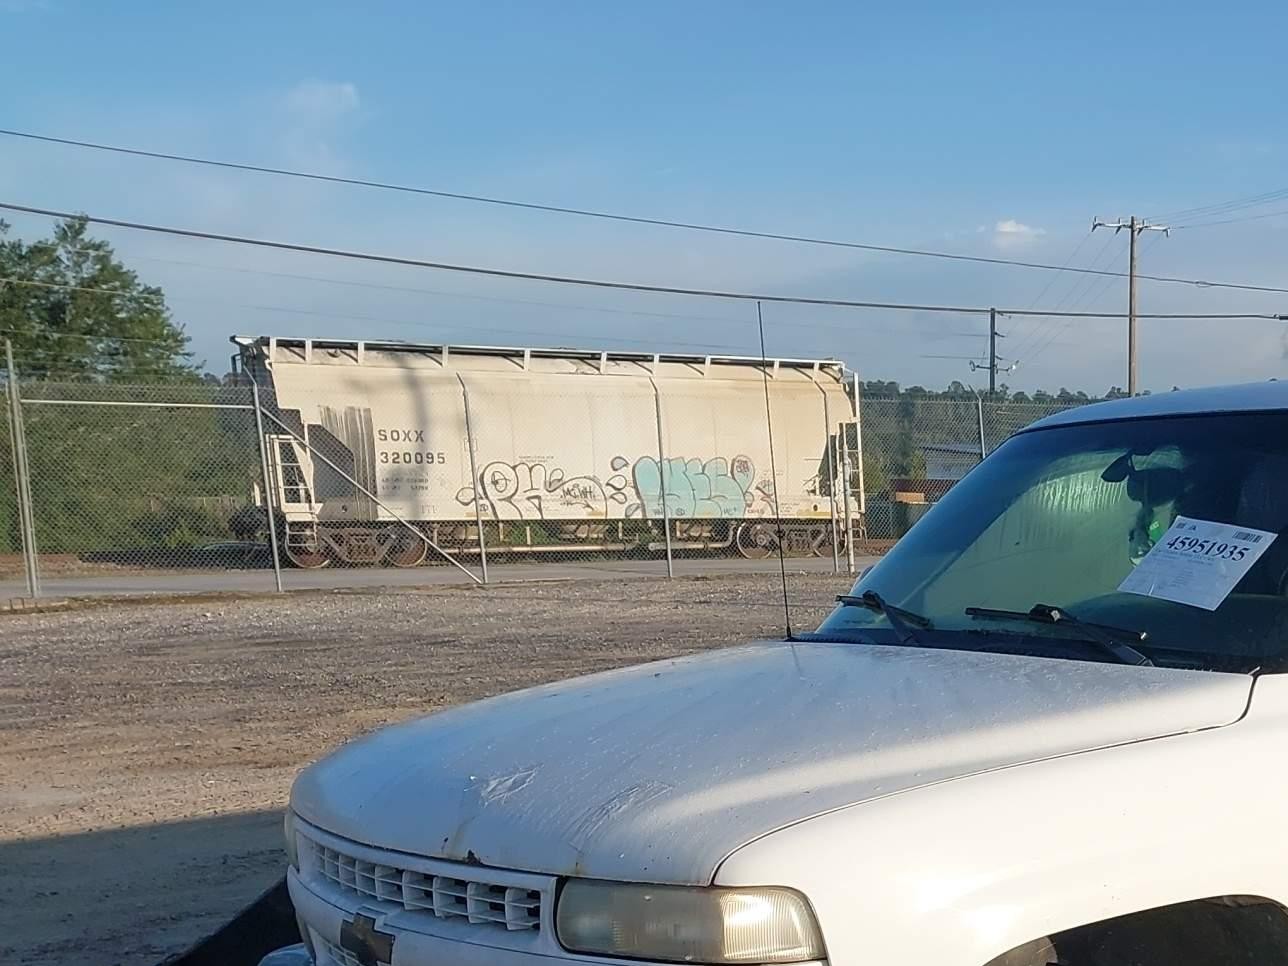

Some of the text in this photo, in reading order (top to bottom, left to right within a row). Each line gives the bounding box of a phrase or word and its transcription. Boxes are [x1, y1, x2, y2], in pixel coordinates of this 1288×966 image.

[377, 429, 425, 442] SOXX
[379, 451, 446, 465] 320095
[1167, 535, 1251, 562] 45951935
